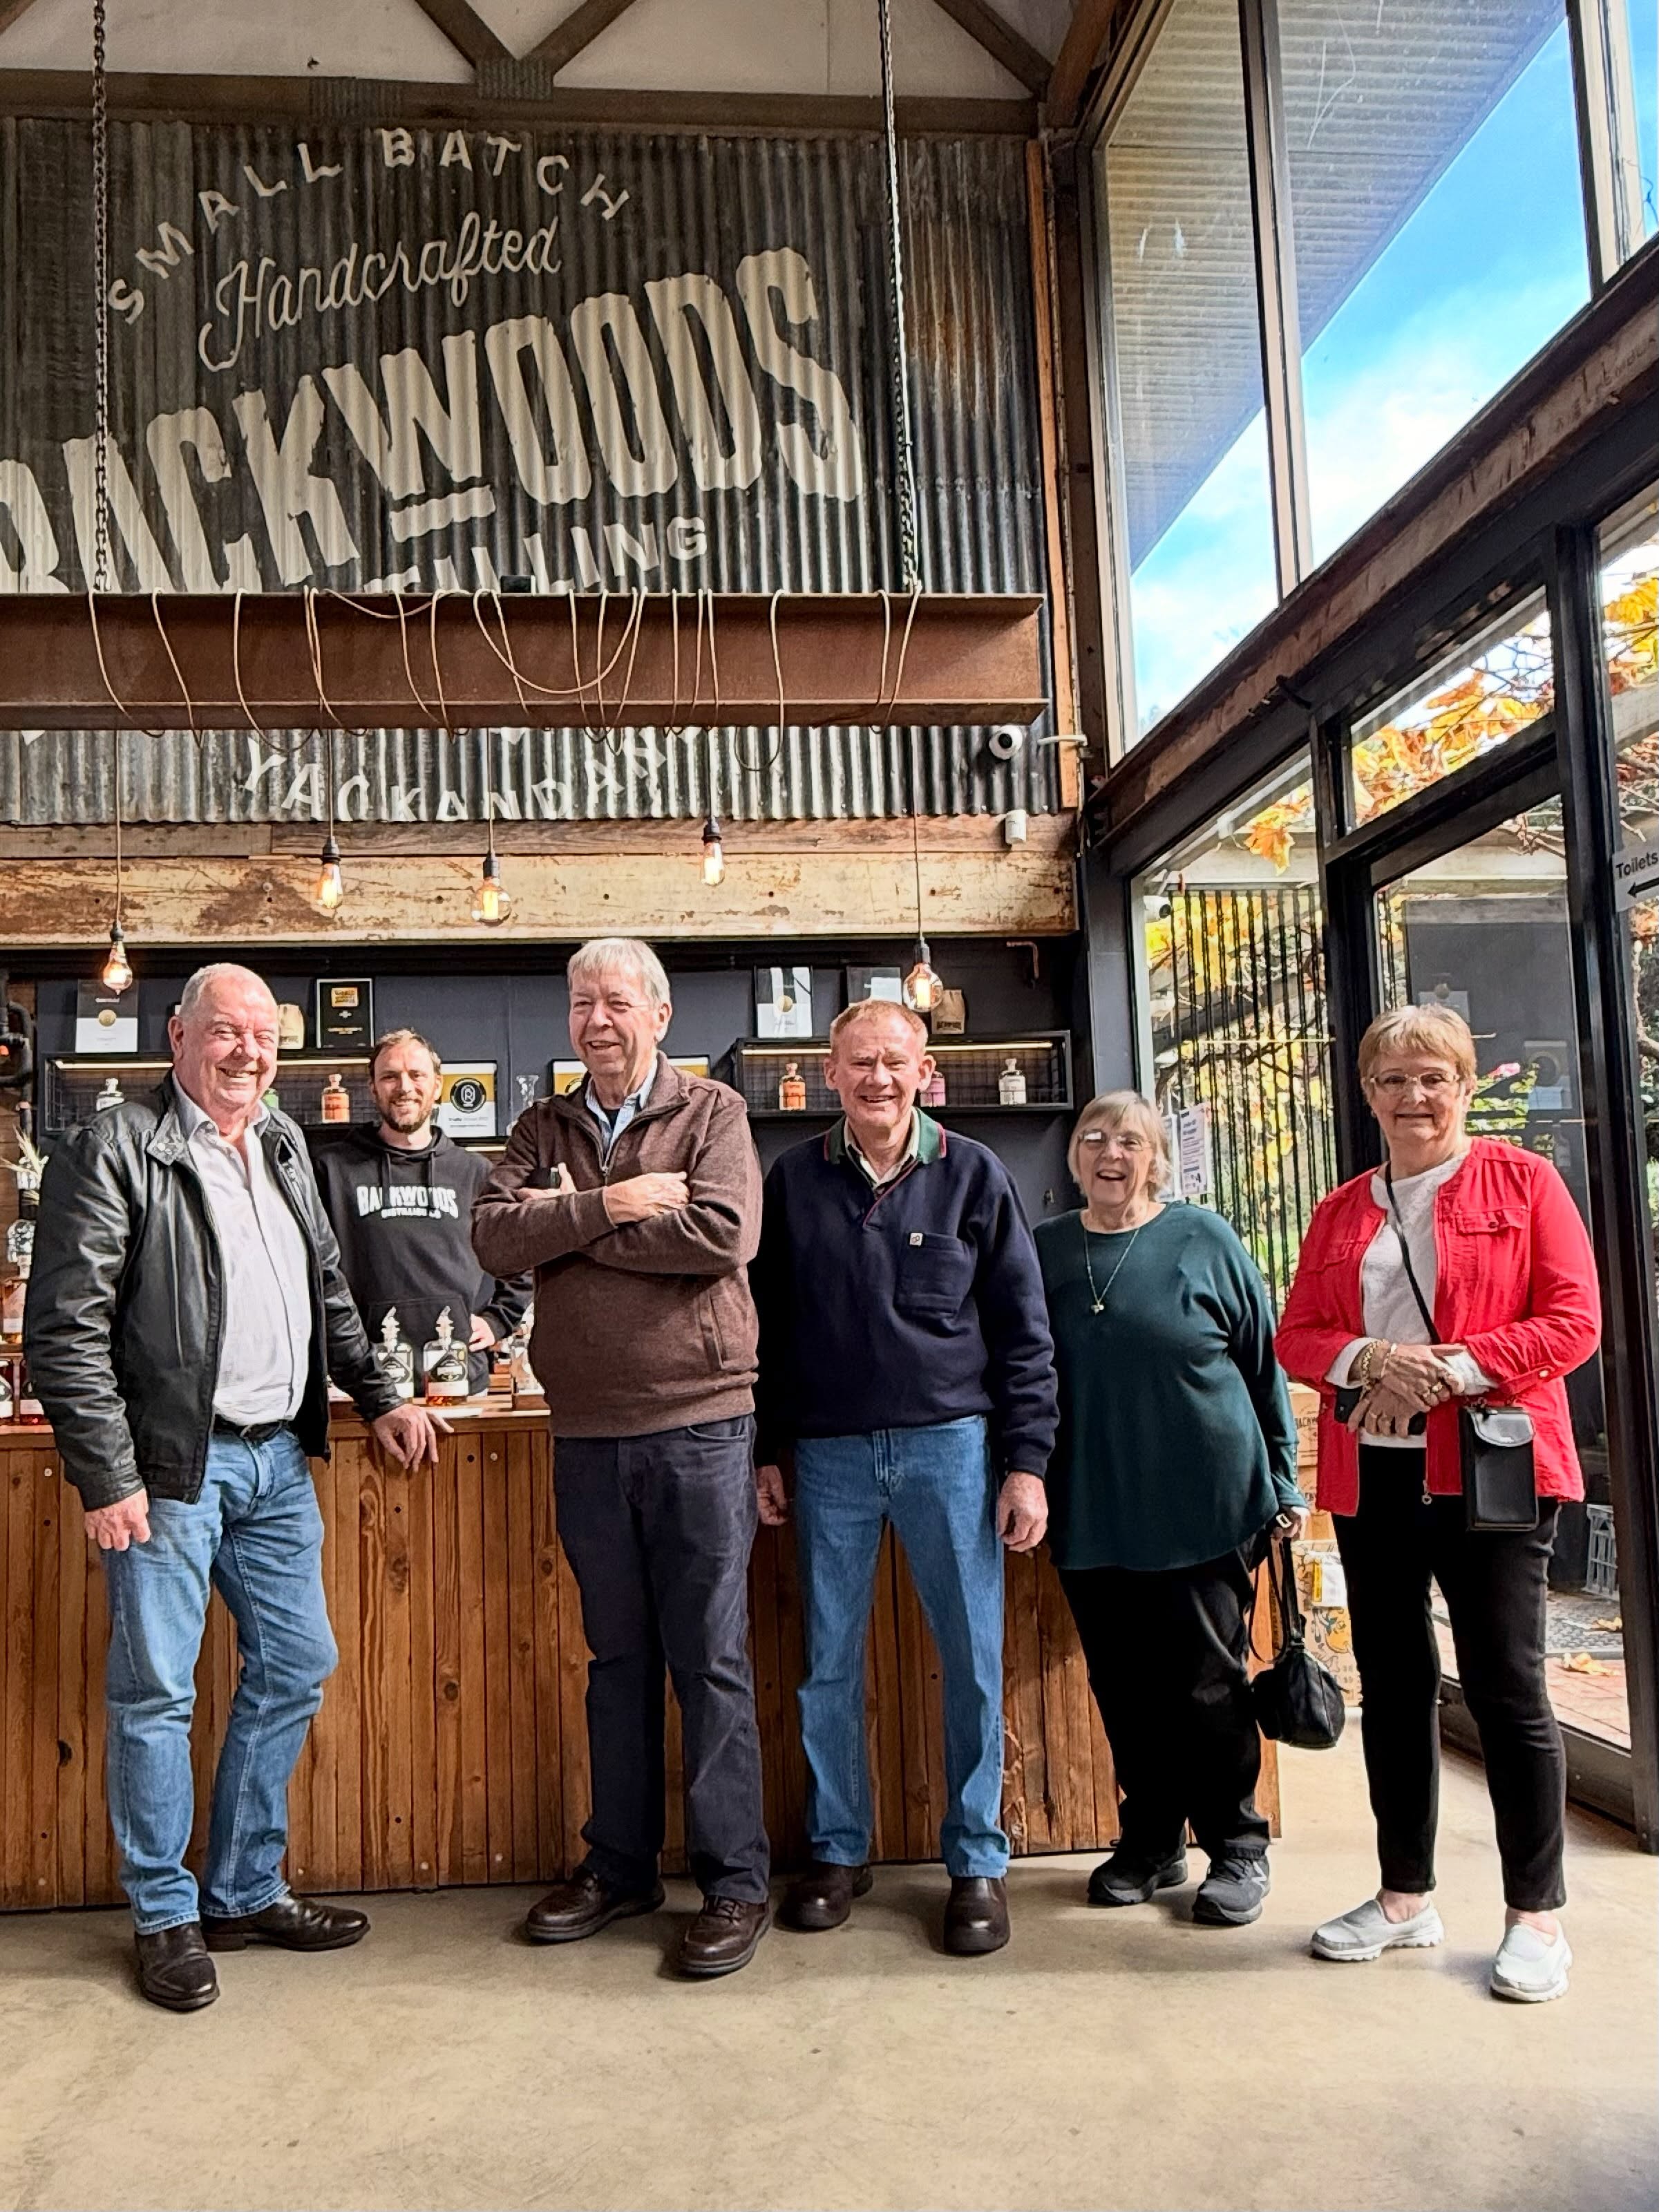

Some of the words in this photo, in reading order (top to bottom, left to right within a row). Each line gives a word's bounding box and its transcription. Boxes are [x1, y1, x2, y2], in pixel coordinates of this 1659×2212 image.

[108, 142, 343, 325] SMALL
[380, 127, 629, 220] BATCH
[198, 211, 562, 372] Handcrafted
[1615, 851, 1658, 879] Toilets
